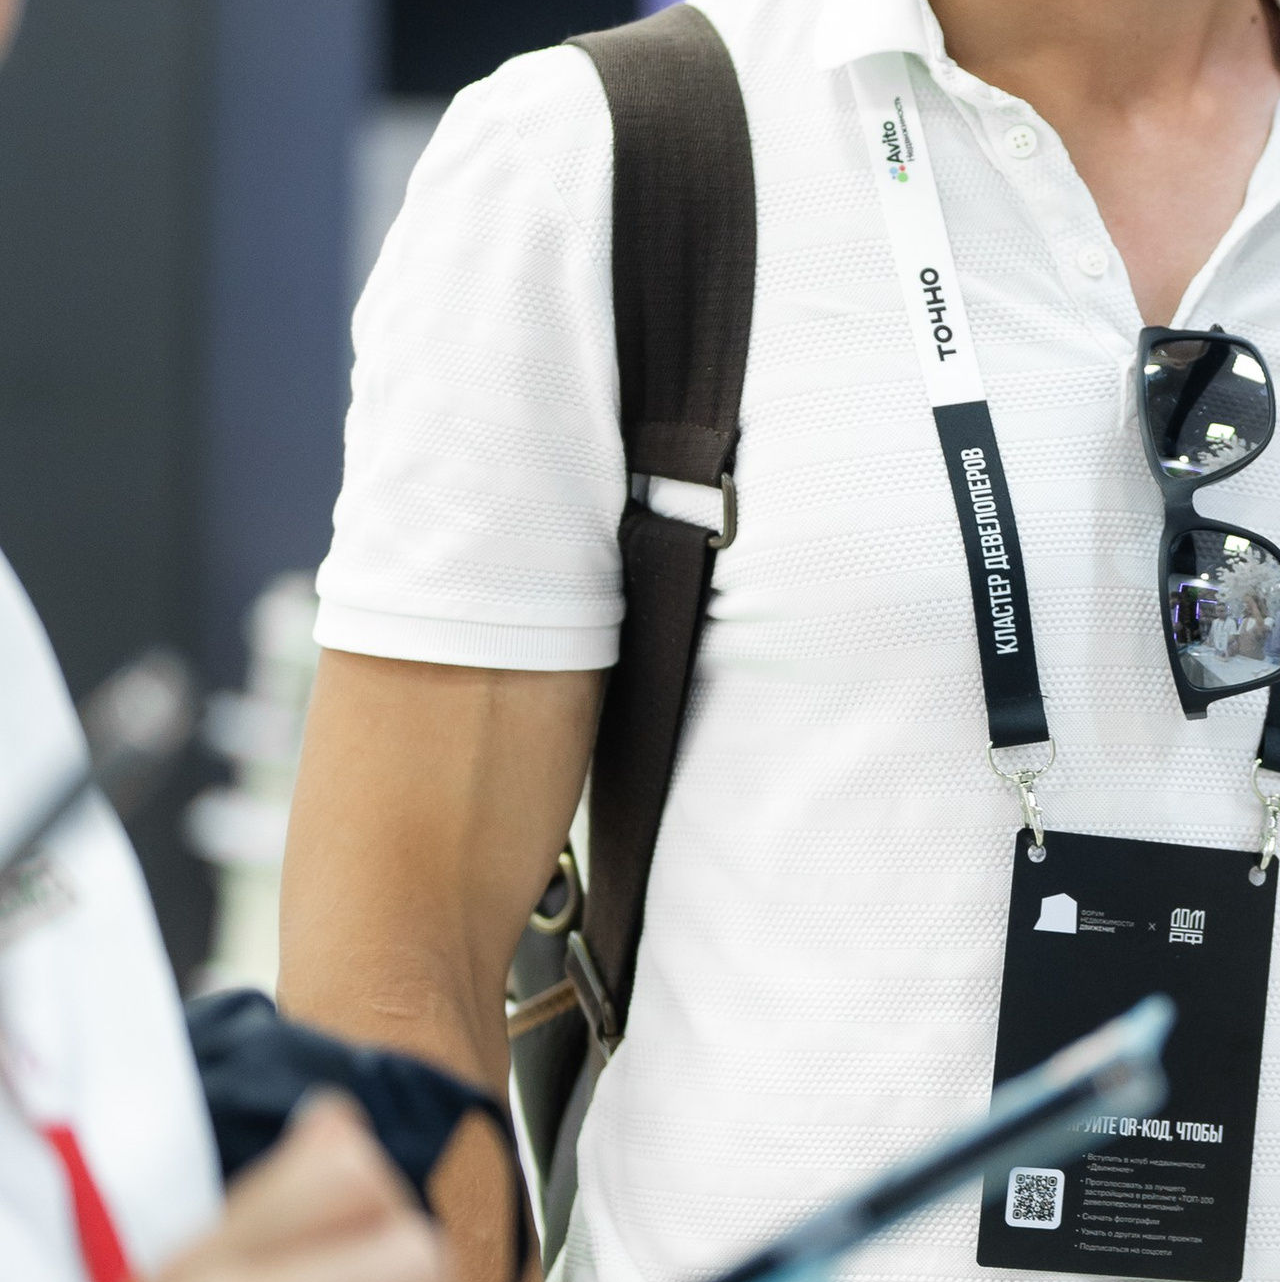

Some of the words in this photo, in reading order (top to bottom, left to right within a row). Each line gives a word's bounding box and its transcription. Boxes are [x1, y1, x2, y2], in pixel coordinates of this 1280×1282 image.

[882, 120, 904, 163] Avito
[920, 267, 957, 362] ТОЧНО
[961, 447, 1010, 571] ДЕВЕЛОПЕРОВ
[987, 573, 1019, 655] КЛАСТЕР
[1170, 908, 1206, 930] ДОМ
[1168, 931, 1204, 946] РФ
[1119, 1117, 1174, 1141] QR-КОД,
[1175, 1121, 1224, 1144] ЧТОБЫ
[1085, 1178, 1143, 1190] Проголосовать
[1082, 1212, 1112, 1222] Скачать
